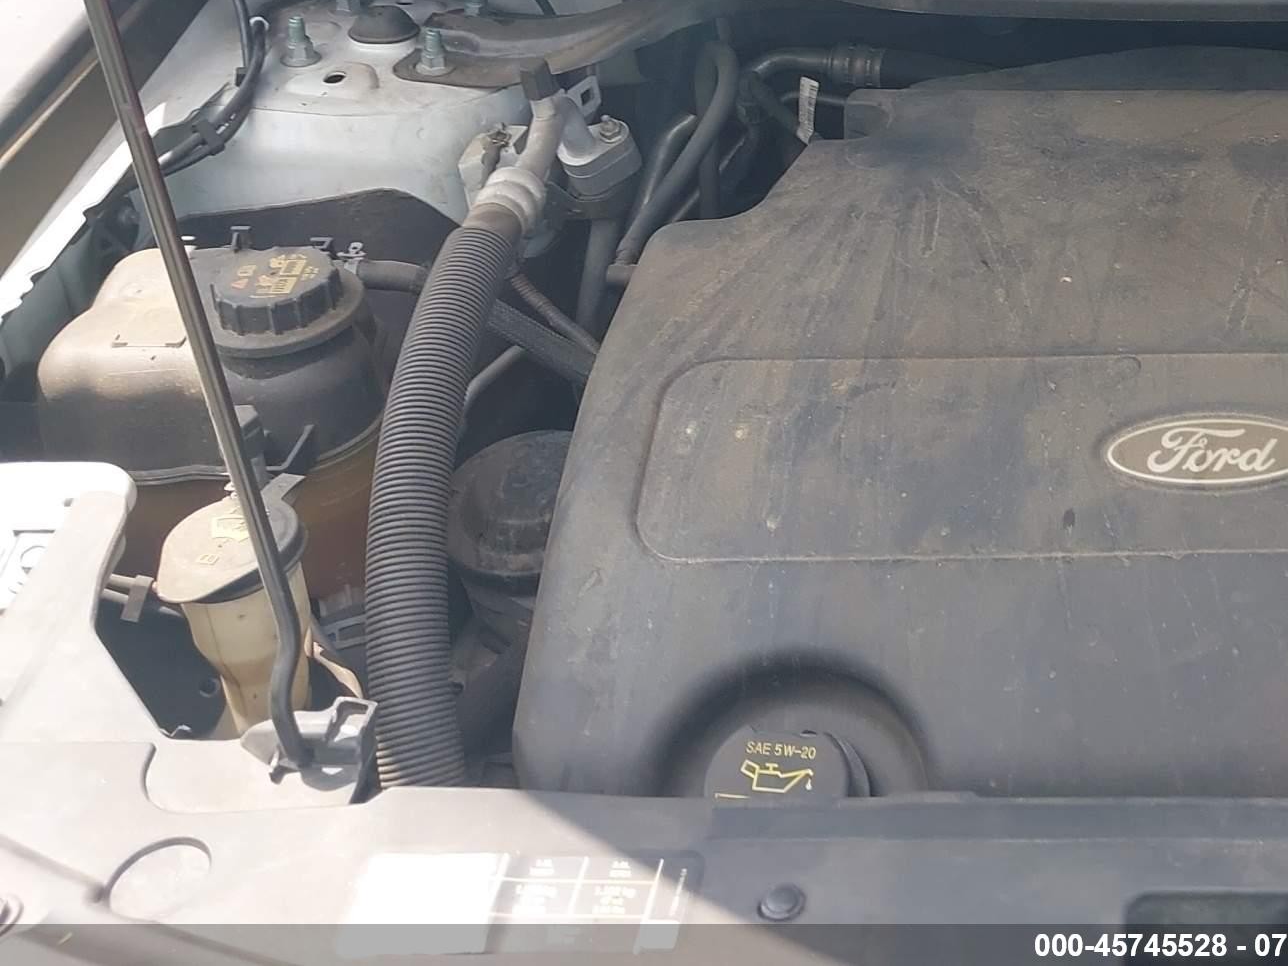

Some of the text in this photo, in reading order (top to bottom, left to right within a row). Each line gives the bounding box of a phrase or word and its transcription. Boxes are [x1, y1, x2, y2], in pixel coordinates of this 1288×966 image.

[1146, 426, 1278, 473] Ford
[745, 740, 817, 760] SAE 5W-20
